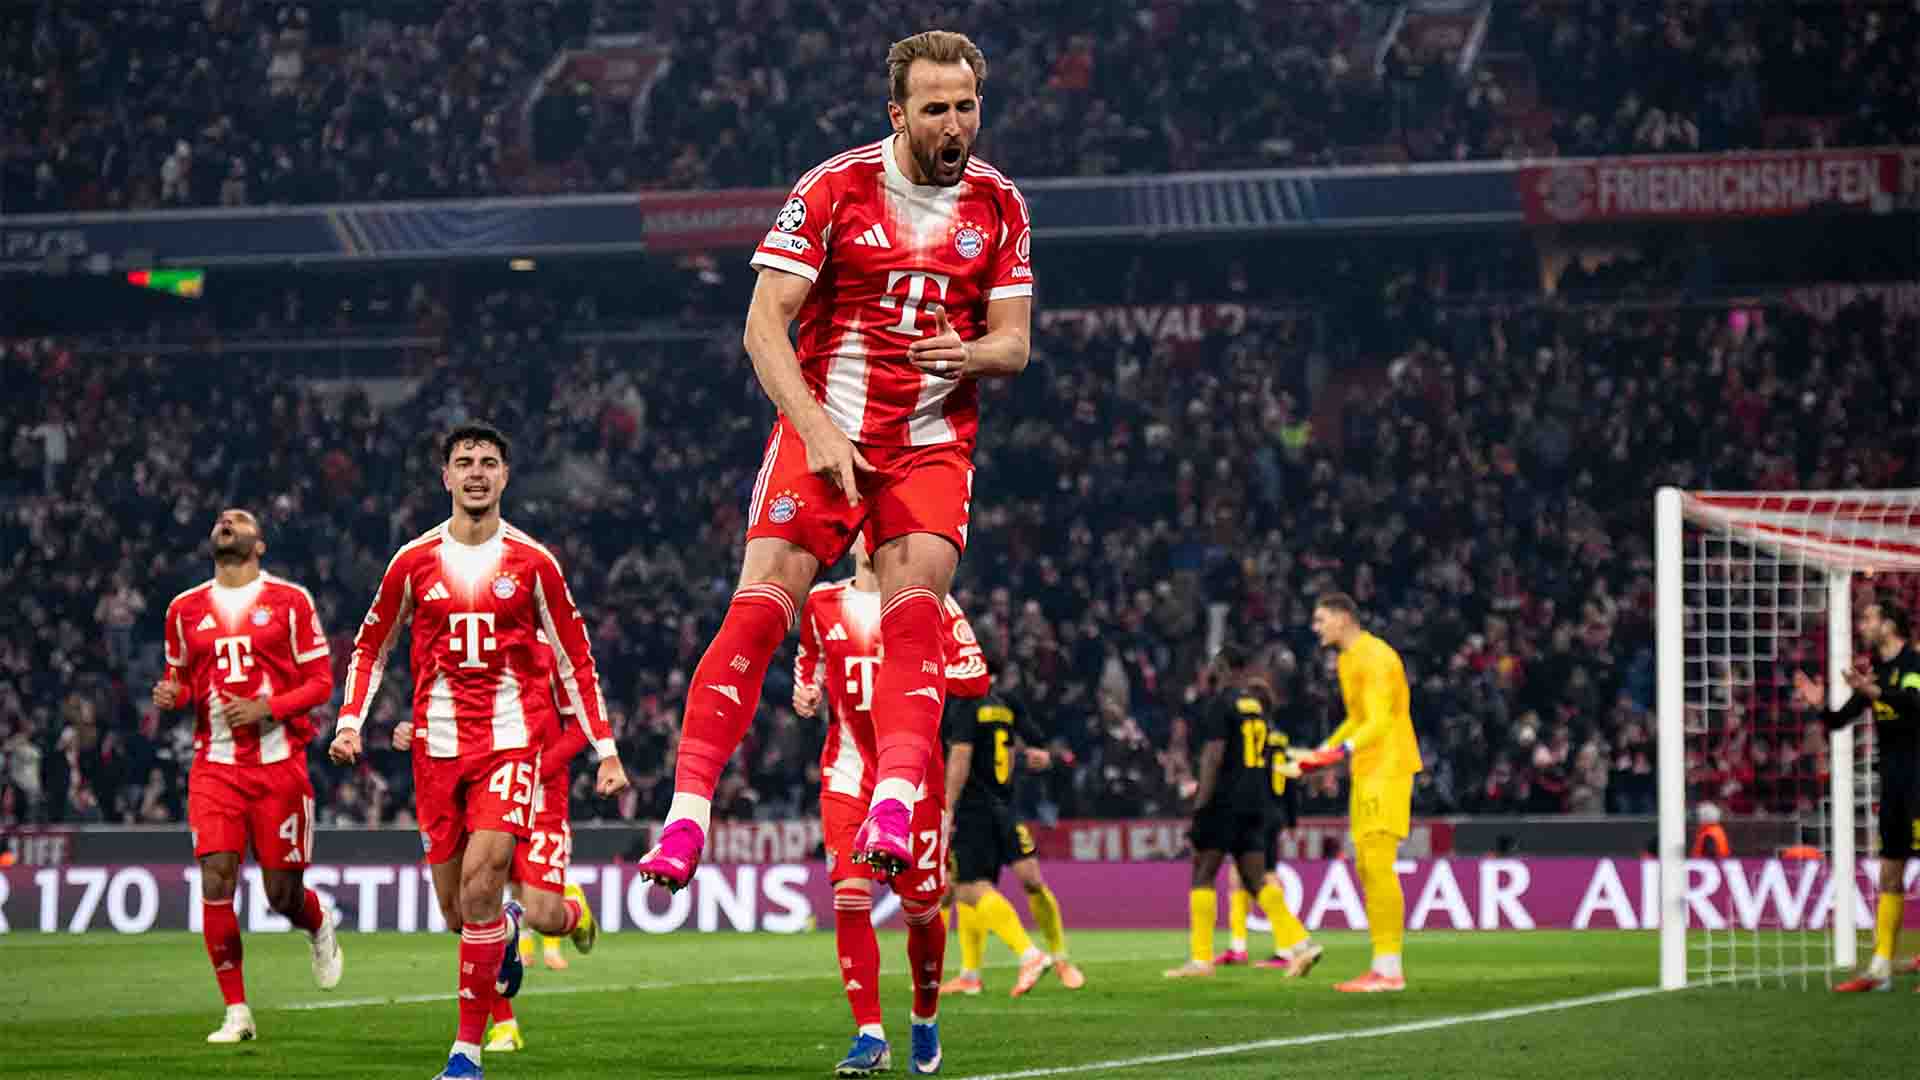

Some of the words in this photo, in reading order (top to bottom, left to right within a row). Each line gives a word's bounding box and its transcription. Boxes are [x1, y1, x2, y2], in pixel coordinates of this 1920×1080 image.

[1598, 160, 1882, 213] FRIEDRICHSHAFEN
[880, 270, 952, 336] T
[215, 635, 254, 683] T
[449, 609, 497, 668] T
[488, 762, 532, 804] 45
[280, 812, 299, 846] 4
[528, 832, 565, 868] 22
[35, 867, 160, 933] 170
[184, 865, 813, 934] ESTIIONS
[1572, 858, 1920, 930] AIRWA
